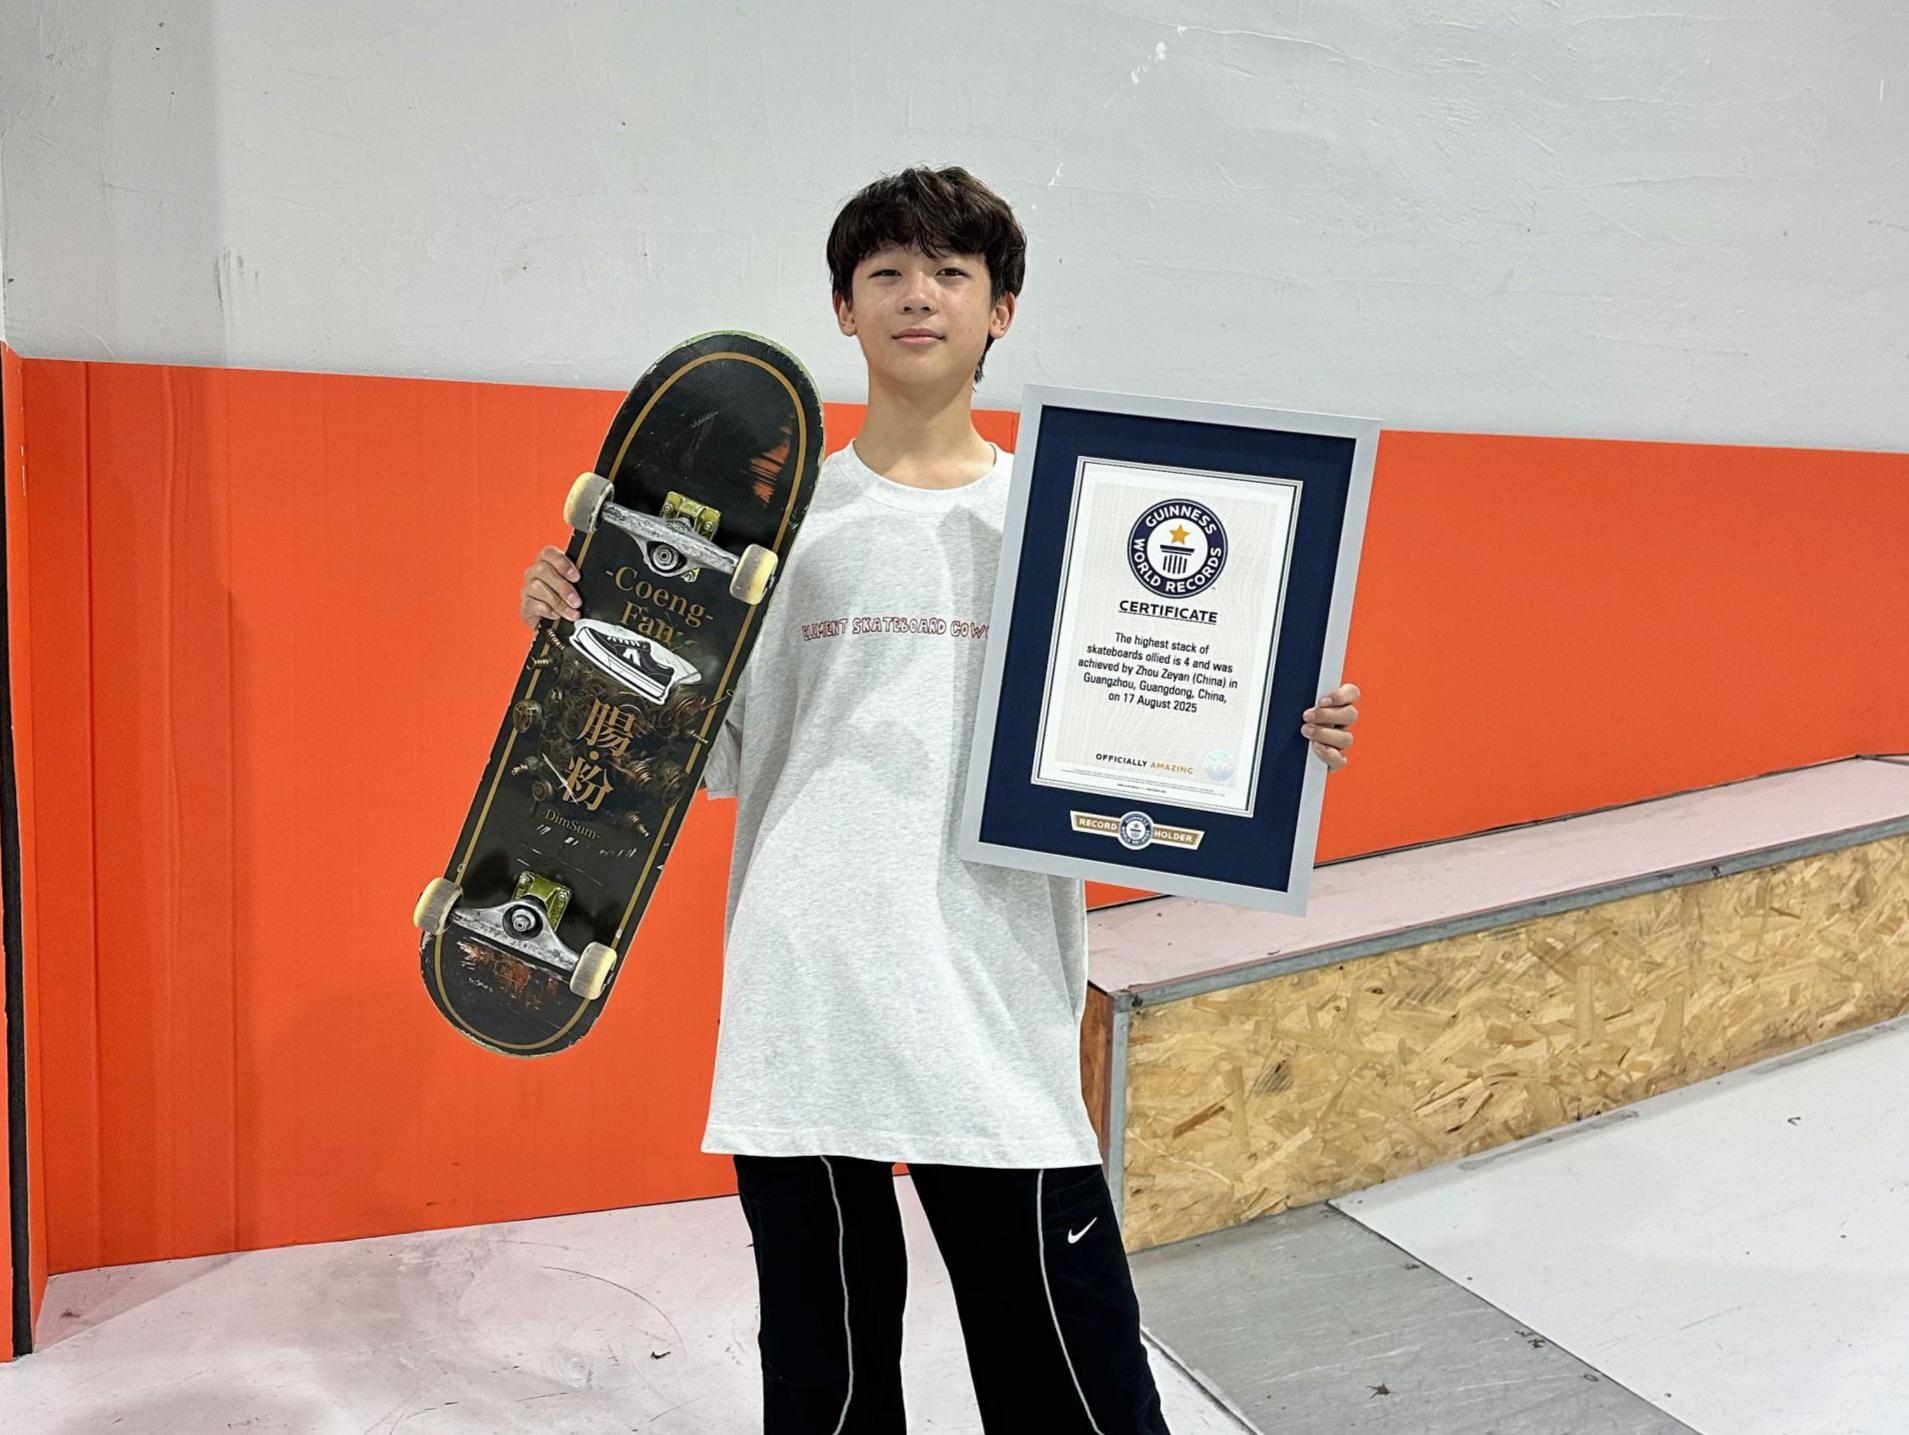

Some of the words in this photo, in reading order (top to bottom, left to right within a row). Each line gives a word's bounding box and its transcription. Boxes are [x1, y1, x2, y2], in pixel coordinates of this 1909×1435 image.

[1145, 504, 1218, 535] GUINNESS
[1134, 538, 1161, 587] WORLD
[1165, 547, 1222, 593] RECORDS
[1119, 600, 1218, 623] CERTIFICATE
[801, 618, 848, 641] ELEMENT
[852, 617, 946, 635] SKATEBOARD
[950, 620, 990, 639] COW
[1115, 632, 1132, 644] The
[1134, 632, 1169, 650] highest
[1171, 638, 1197, 653] stack
[1200, 644, 1210, 655] of
[1086, 644, 1143, 661] skateboards
[1145, 651, 1170, 665] ollied
[1173, 655, 1181, 666] is
[1184, 656, 1190, 667] 4
[1192, 657, 1211, 671] and
[1212, 663, 1234, 674] was
[1078, 657, 1119, 673] achieved
[1121, 664, 1134, 676] by
[1135, 664, 1159, 679] Zhou
[1161, 669, 1190, 684] Zeyan
[1192, 672, 1227, 689] (China)
[1228, 678, 1238, 689] in
[1083, 672, 1136, 691] Guangzhou,
[1139, 680, 1195, 700] Guangdong,
[1197, 688, 1228, 704] China,
[1108, 692, 1120, 702] on
[1124, 693, 1135, 704] 17
[1137, 695, 1171, 710] August
[1173, 701, 1198, 713] 2025
[1095, 753, 1148, 768] OFFICIALLY
[1150, 761, 1194, 775] AMAZING
[1079, 818, 1118, 831] RECORD
[1153, 830, 1193, 843] HOLDER
